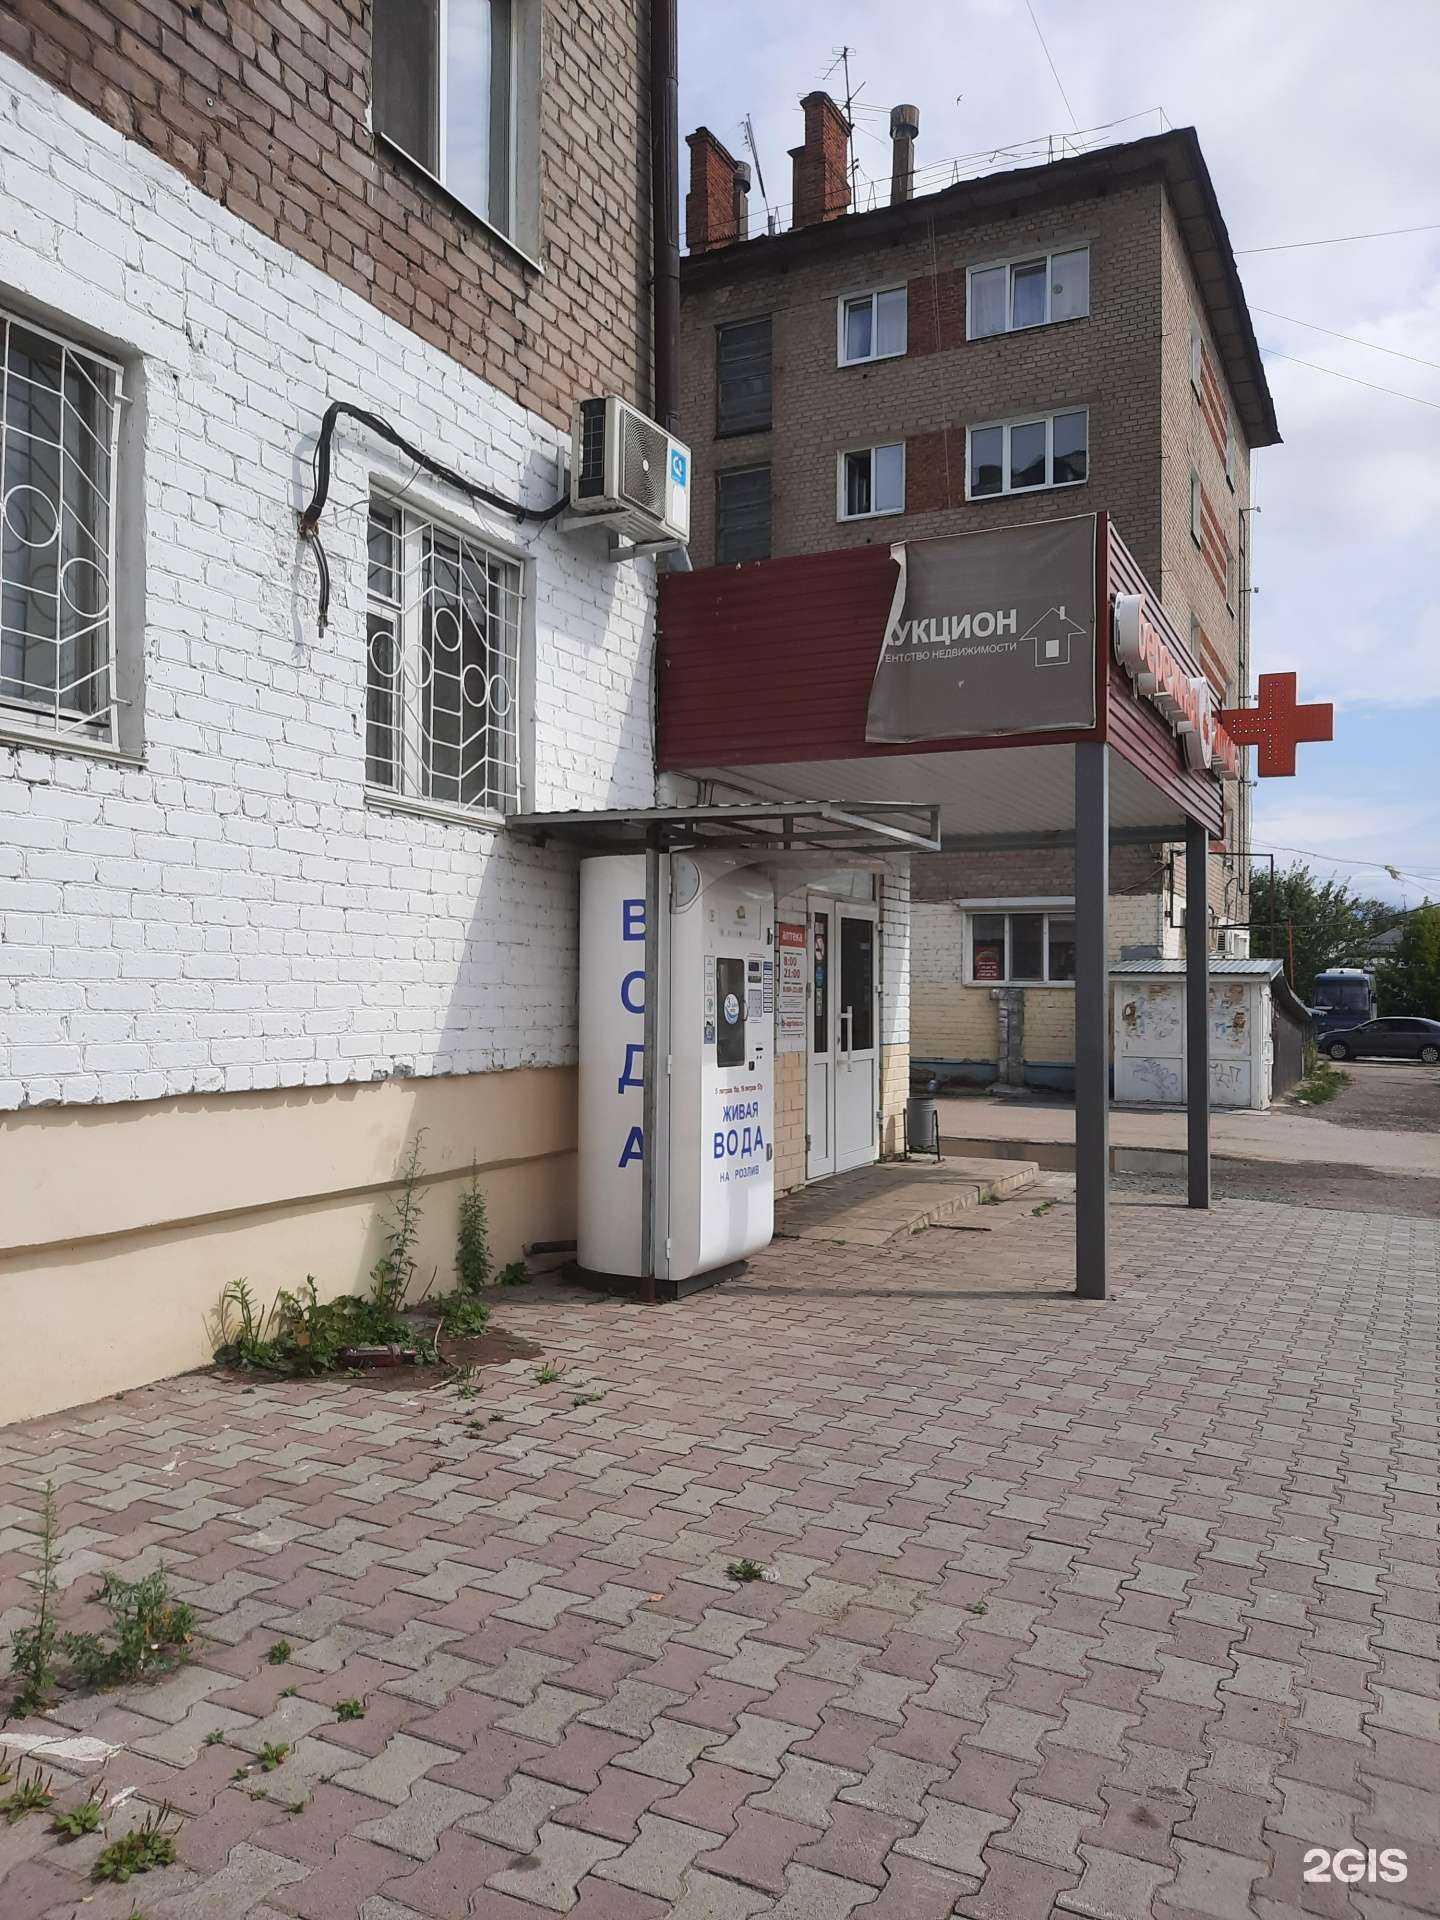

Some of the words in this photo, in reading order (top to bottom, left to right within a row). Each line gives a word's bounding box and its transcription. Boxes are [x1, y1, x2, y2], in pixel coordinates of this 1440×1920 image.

[887, 608, 1017, 646] УКЦИОН
[932, 642, 1017, 660] НЕДВИЖИМОСТИ
[723, 1101, 759, 1122] ЖИВАЯ
[713, 1125, 764, 1159] ВОДА
[719, 1172, 730, 1183] НА
[734, 1165, 760, 1180] РОЗЛИВ
